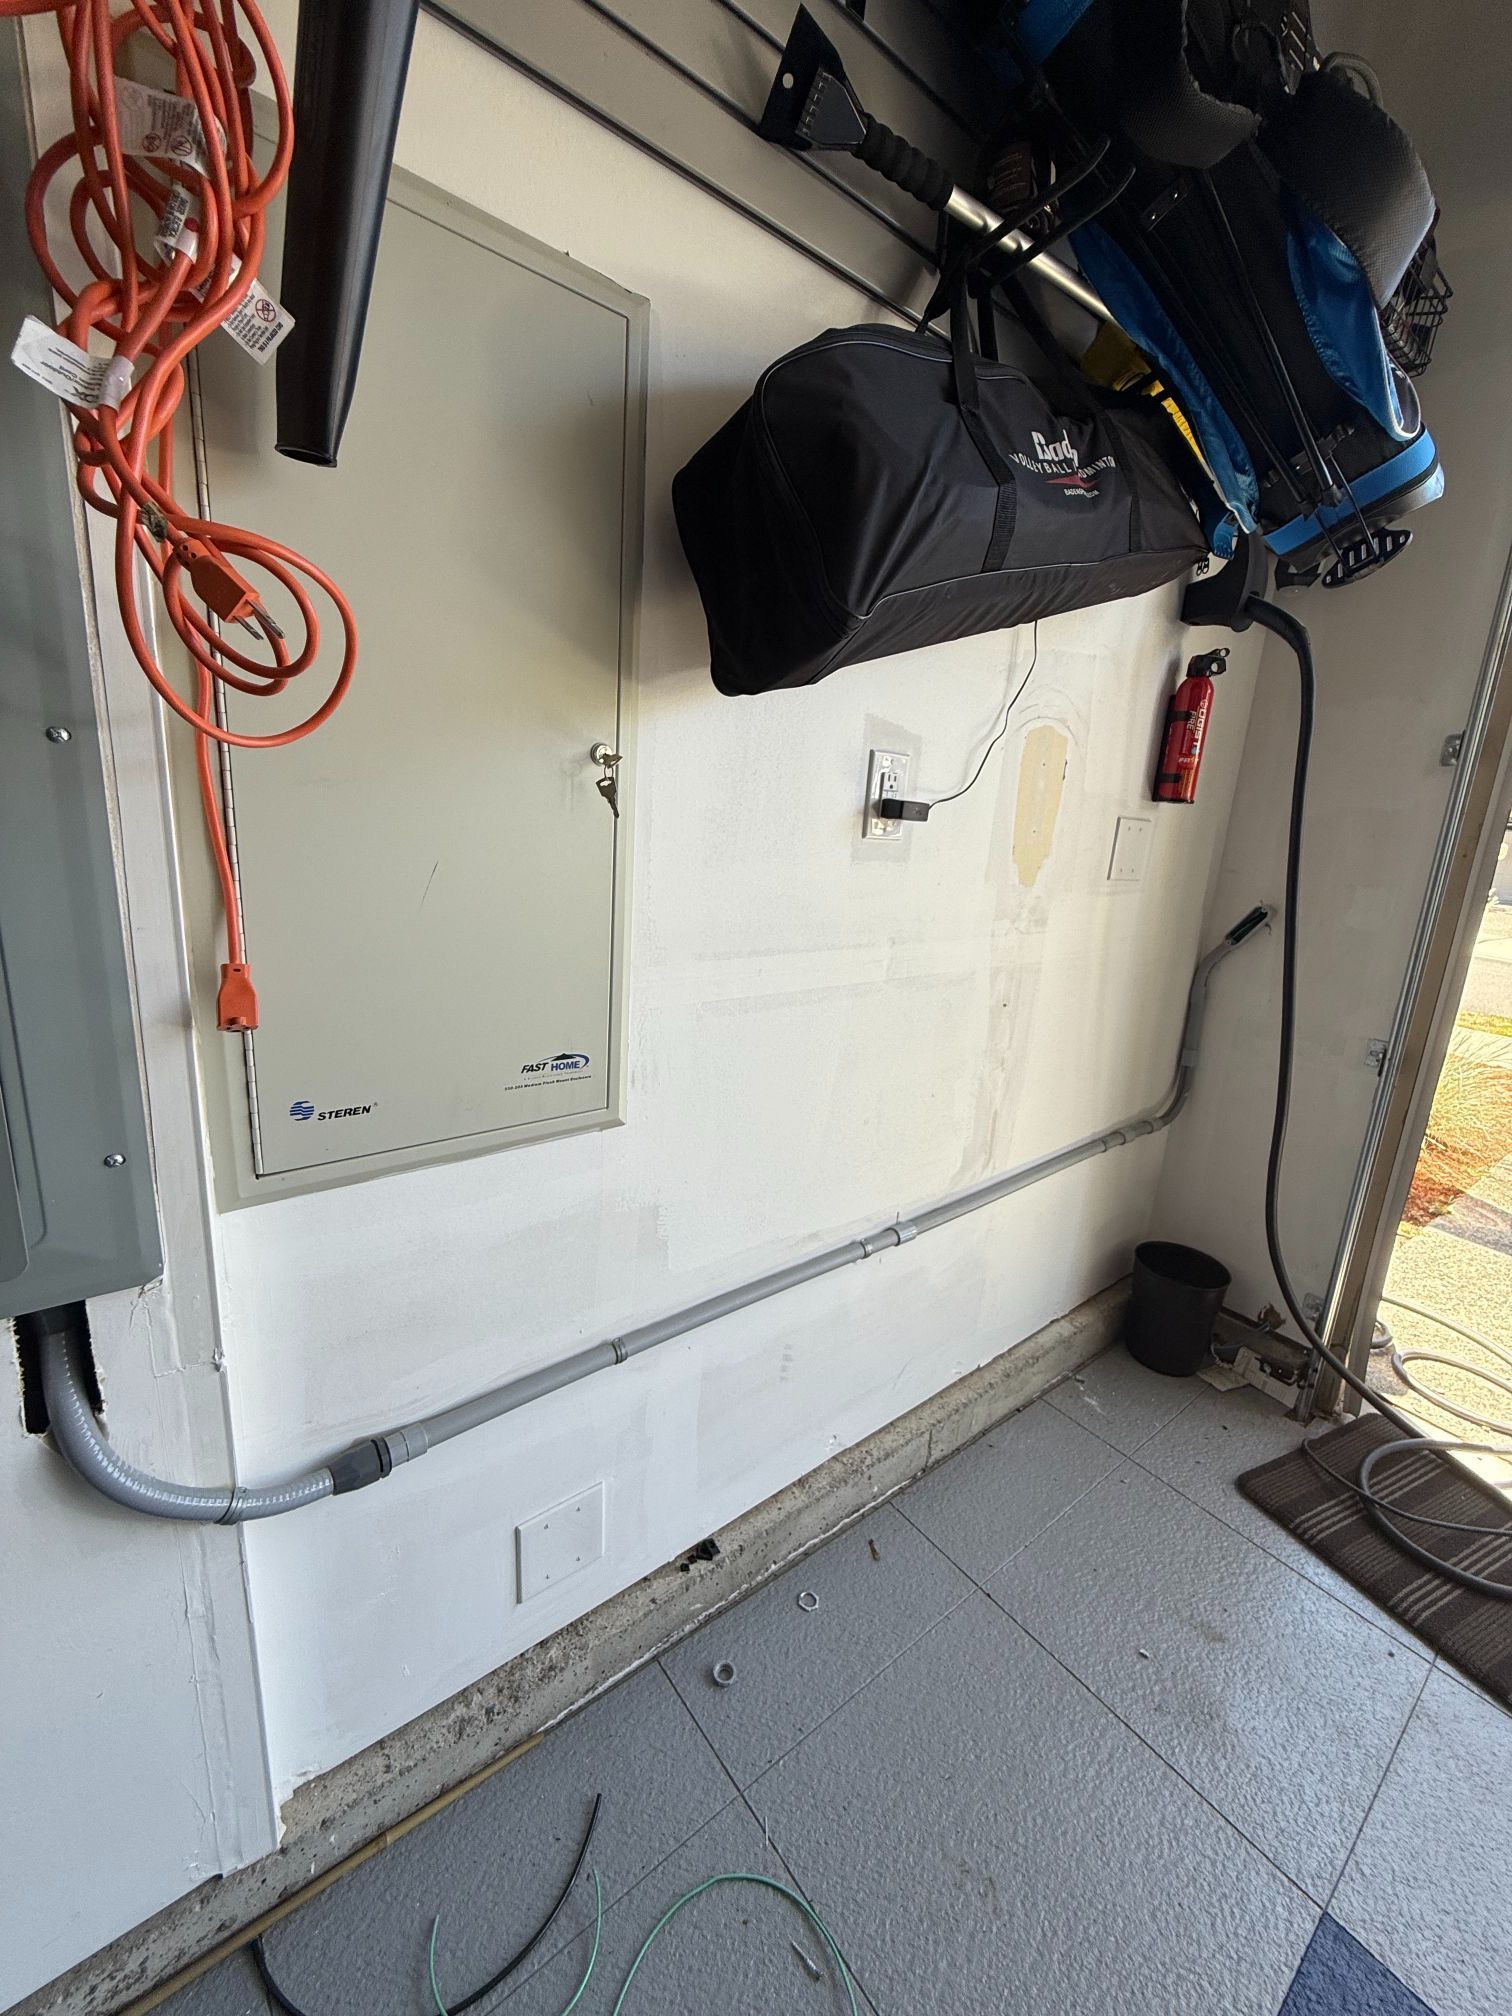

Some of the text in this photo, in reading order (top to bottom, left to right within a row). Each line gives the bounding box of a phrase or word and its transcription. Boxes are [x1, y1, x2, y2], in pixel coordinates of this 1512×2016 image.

[520, 1060, 580, 1074] FAST HOME
[317, 1104, 372, 1121] STEREN
